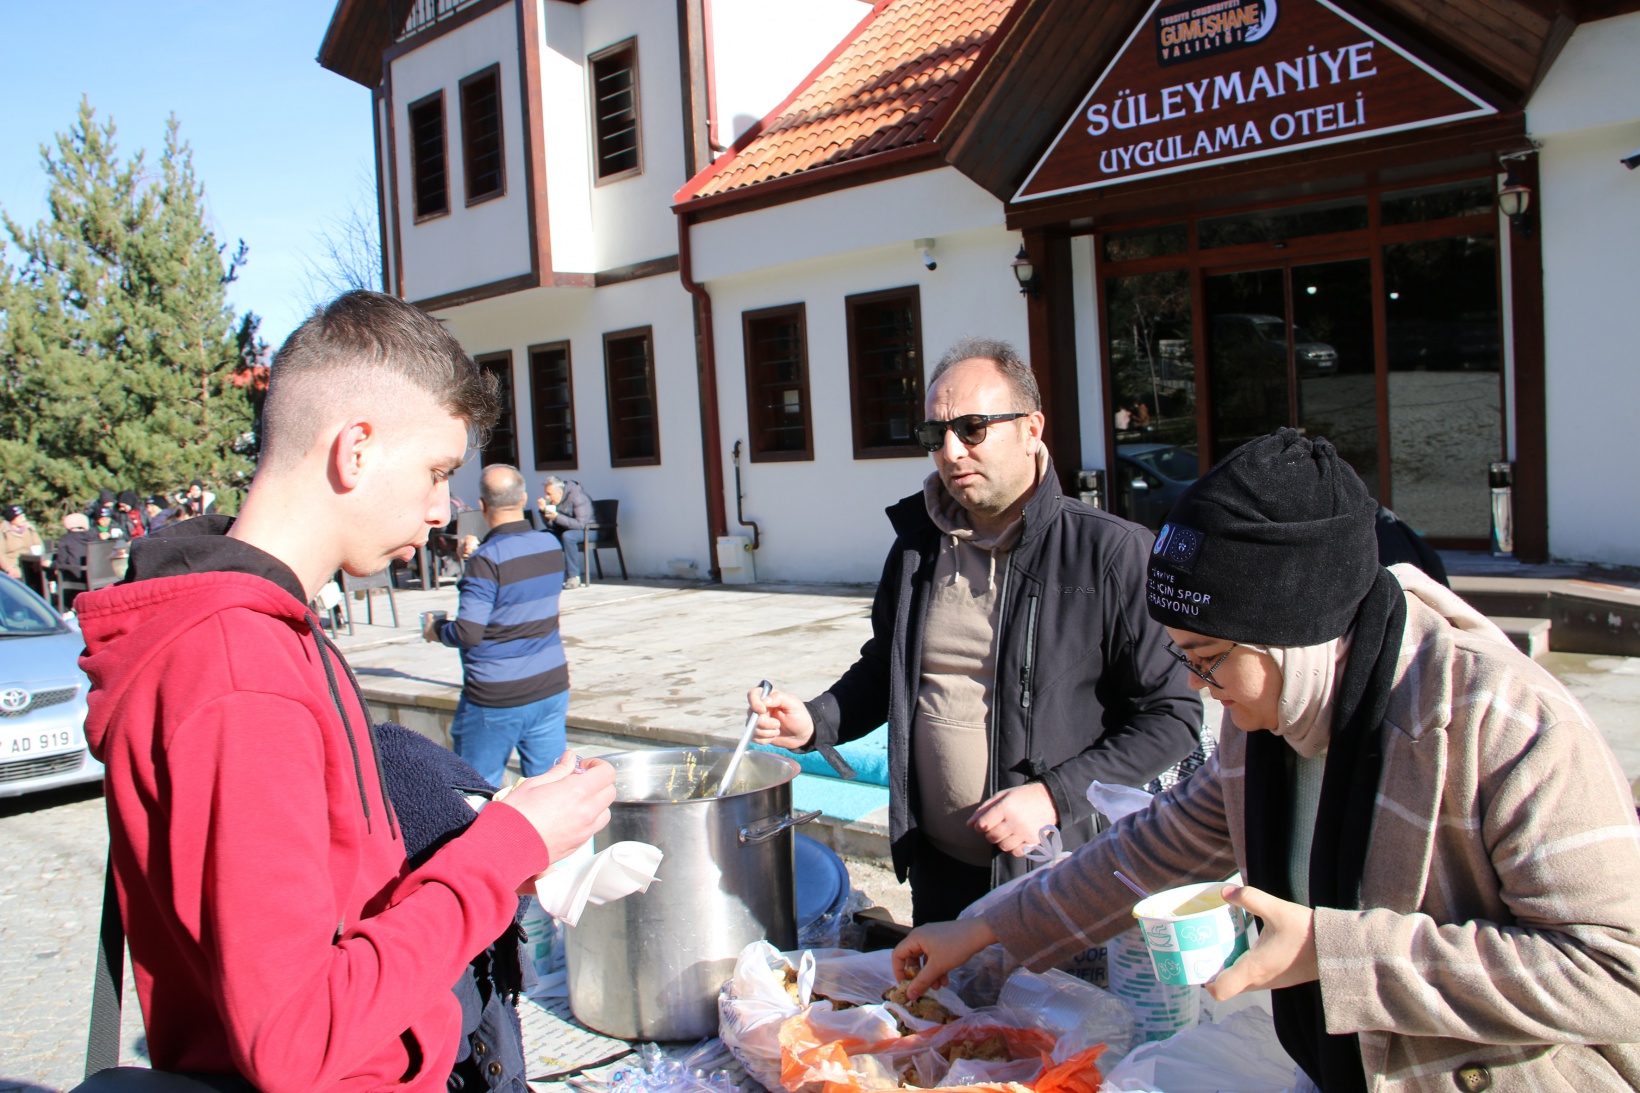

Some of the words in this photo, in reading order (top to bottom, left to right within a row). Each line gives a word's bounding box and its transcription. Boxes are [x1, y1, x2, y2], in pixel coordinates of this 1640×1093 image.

[1087, 41, 1377, 136] SÜLEYMANİYE
[1099, 120, 1262, 173] UYGULAMA
[1270, 91, 1366, 141] OTELİ
[1177, 589, 1211, 605] SPOR
[11, 738, 31, 753] AD
[39, 731, 69, 749] 919
